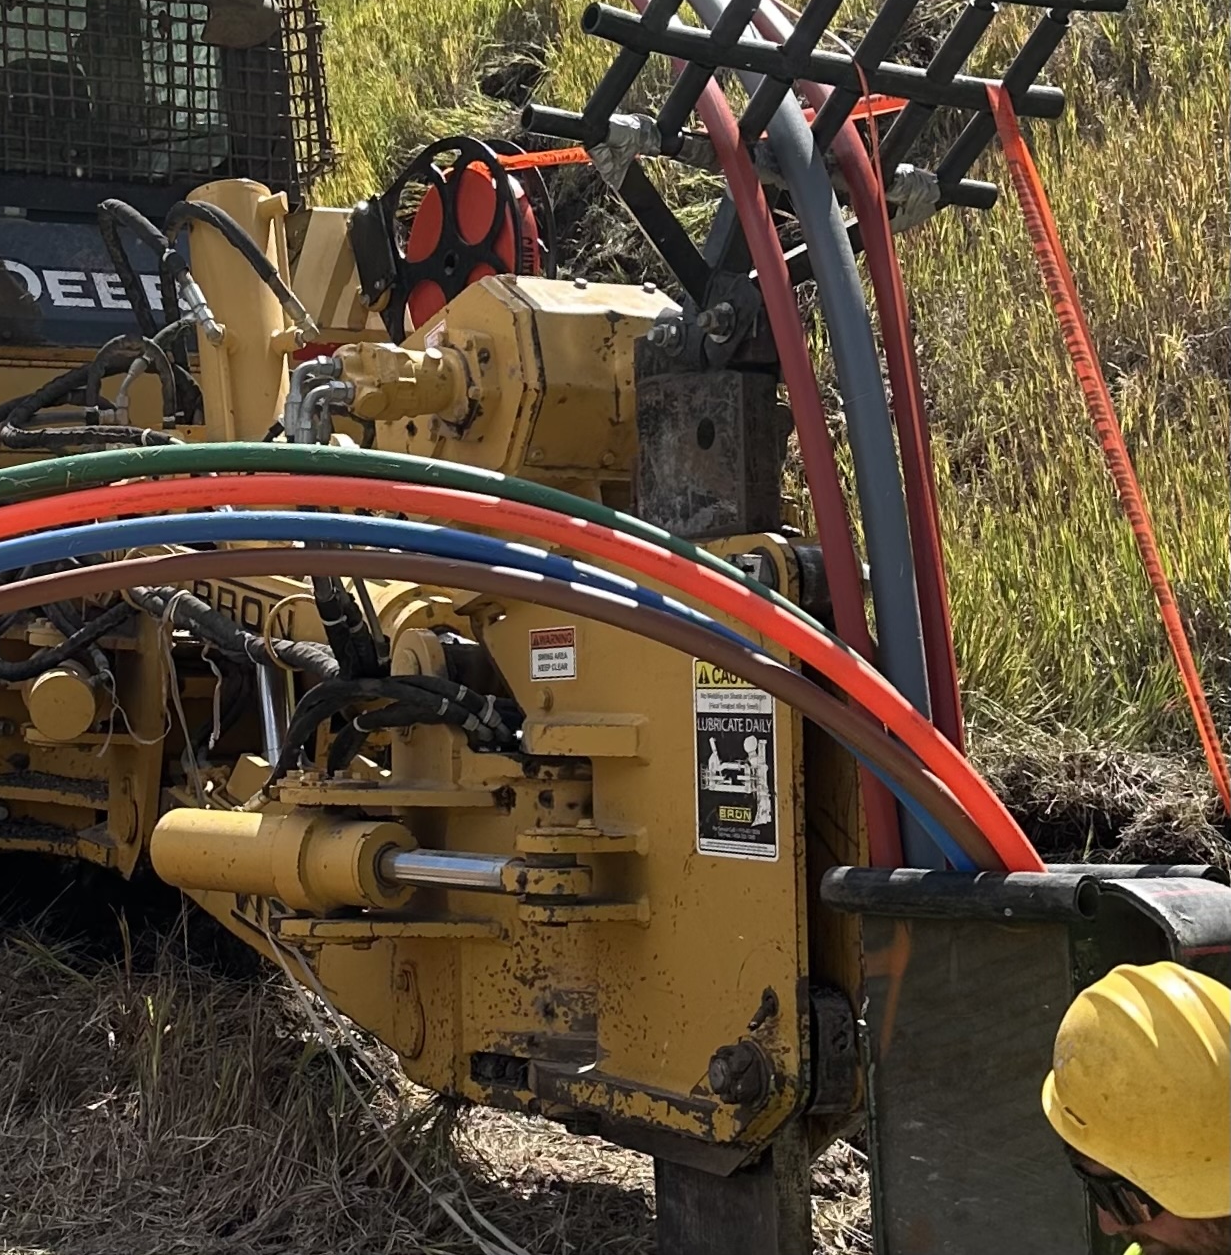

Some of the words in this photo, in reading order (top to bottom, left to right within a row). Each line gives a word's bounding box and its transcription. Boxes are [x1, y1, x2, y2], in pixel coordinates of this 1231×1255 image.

[193, 579, 294, 641] BRON
[538, 631, 573, 645] WARNING
[537, 663, 551, 672] KEEP
[552, 662, 568, 671] CLEAR
[697, 716, 744, 732] LUBRICATE
[745, 717, 772, 733] DAILY
[719, 807, 752, 821] BRON
